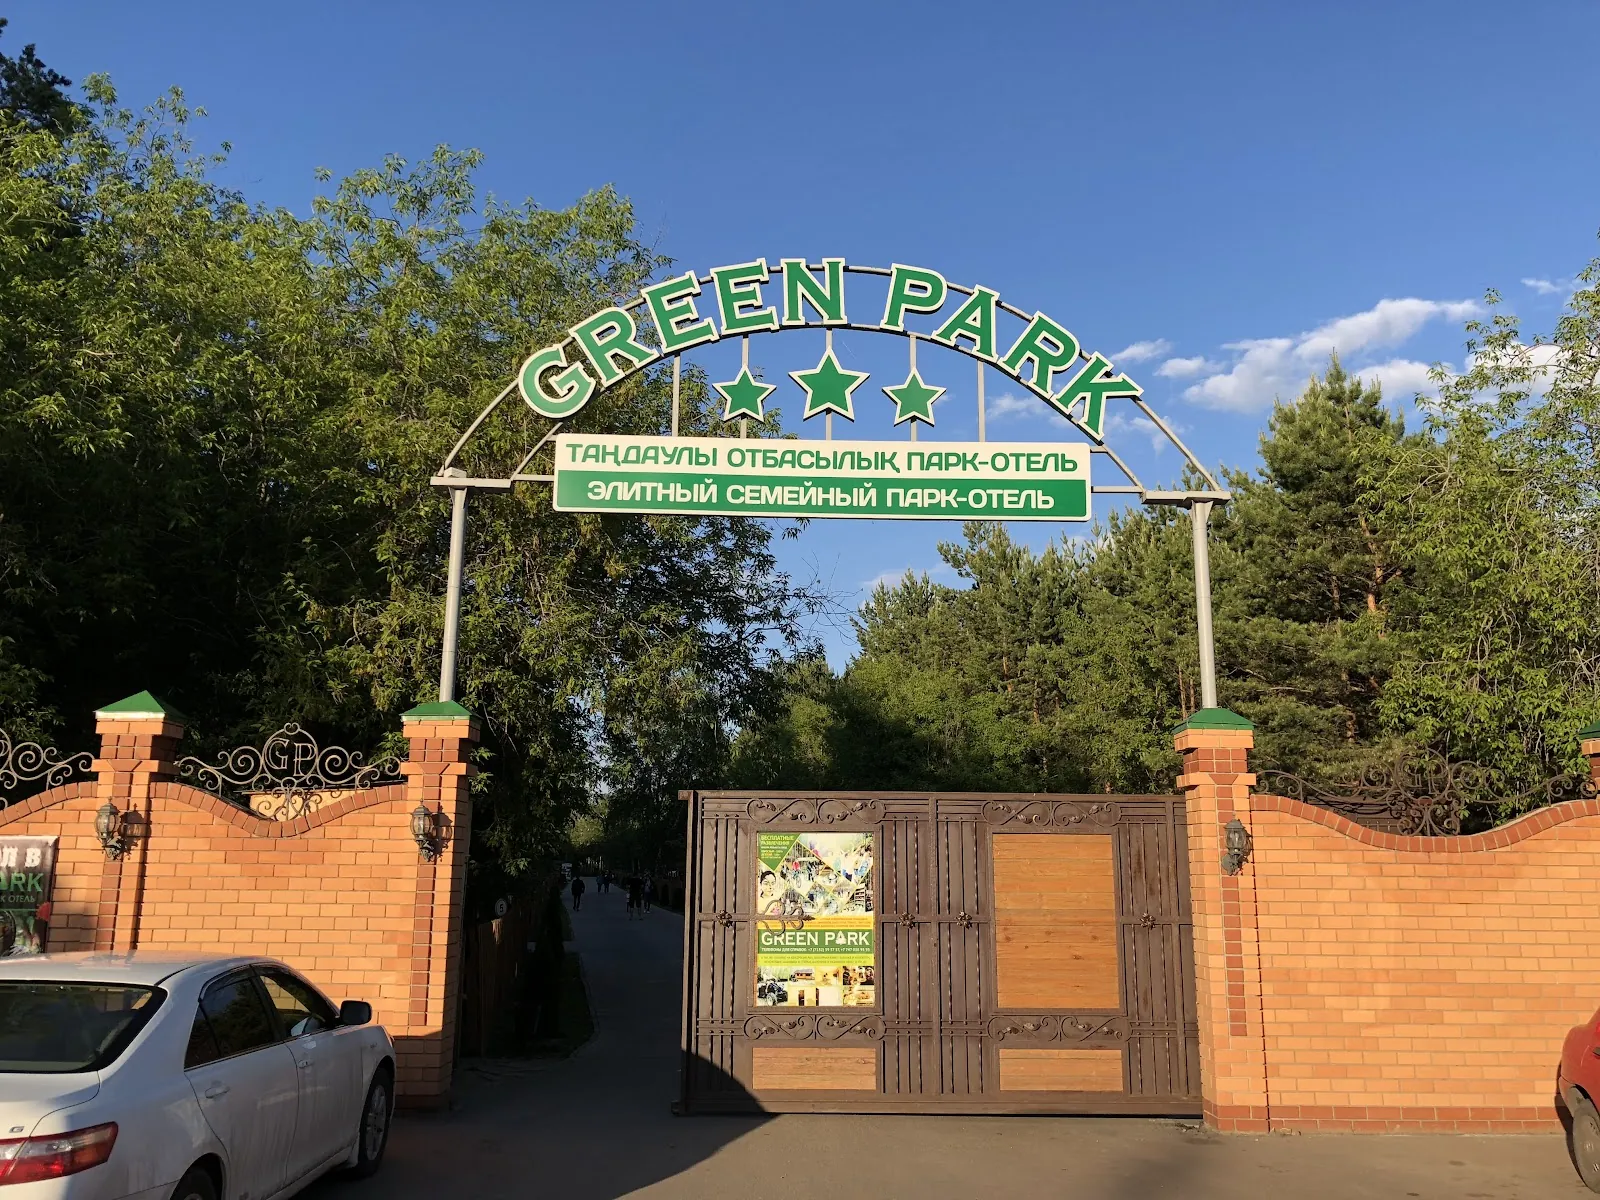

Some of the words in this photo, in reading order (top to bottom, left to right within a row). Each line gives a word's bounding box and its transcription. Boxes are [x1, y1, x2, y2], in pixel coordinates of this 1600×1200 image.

[518, 258, 848, 418] GREEN
[880, 263, 1144, 440] PARK
[566, 443, 718, 467] ТАҢДАУЛЫ
[727, 448, 901, 473] ОТБАСЫЛЫҚ
[907, 452, 1078, 472] ПАРК-ОТЕЛЬ
[587, 478, 718, 503] ЭЛИТНЫЙ
[726, 480, 877, 508] СЕМЕЙНЫЙ
[886, 488, 1055, 509] ПАРК-ОТЕЛЬ
[8, 895, 36, 903] ОТЕЛЬ
[761, 931, 819, 946] GREEN
[825, 930, 870, 946] PARK
